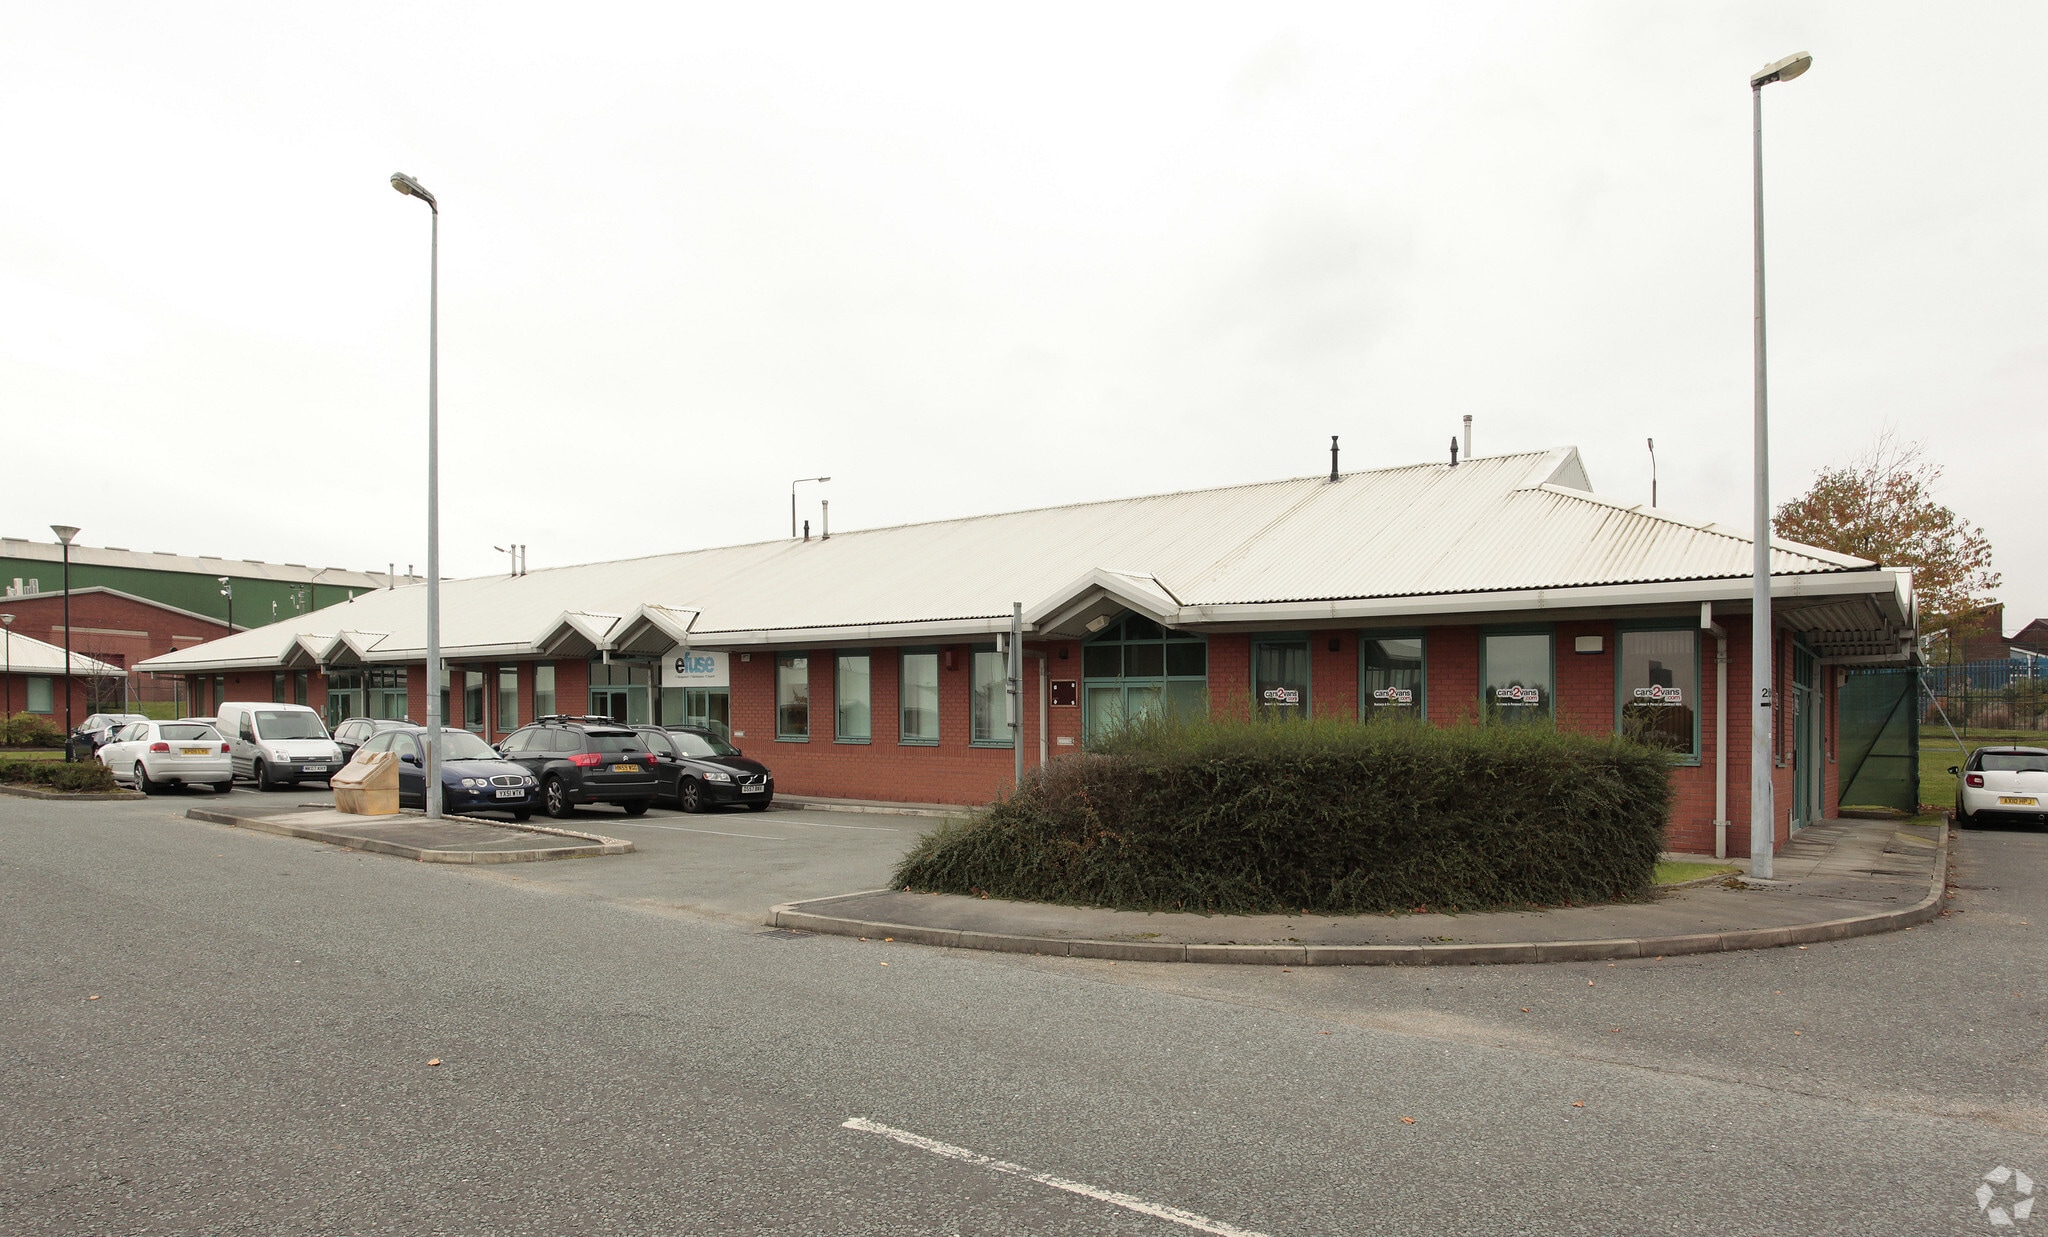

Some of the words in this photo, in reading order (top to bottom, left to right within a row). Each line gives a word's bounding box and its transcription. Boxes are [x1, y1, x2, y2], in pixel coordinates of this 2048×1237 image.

[675, 652, 715, 673] efuse
[1265, 688, 1298, 698] cars2vans
[1375, 688, 1411, 698] cars2vans
[1497, 687, 1537, 697] cars2vans
[1635, 686, 1680, 697] cars2vans
